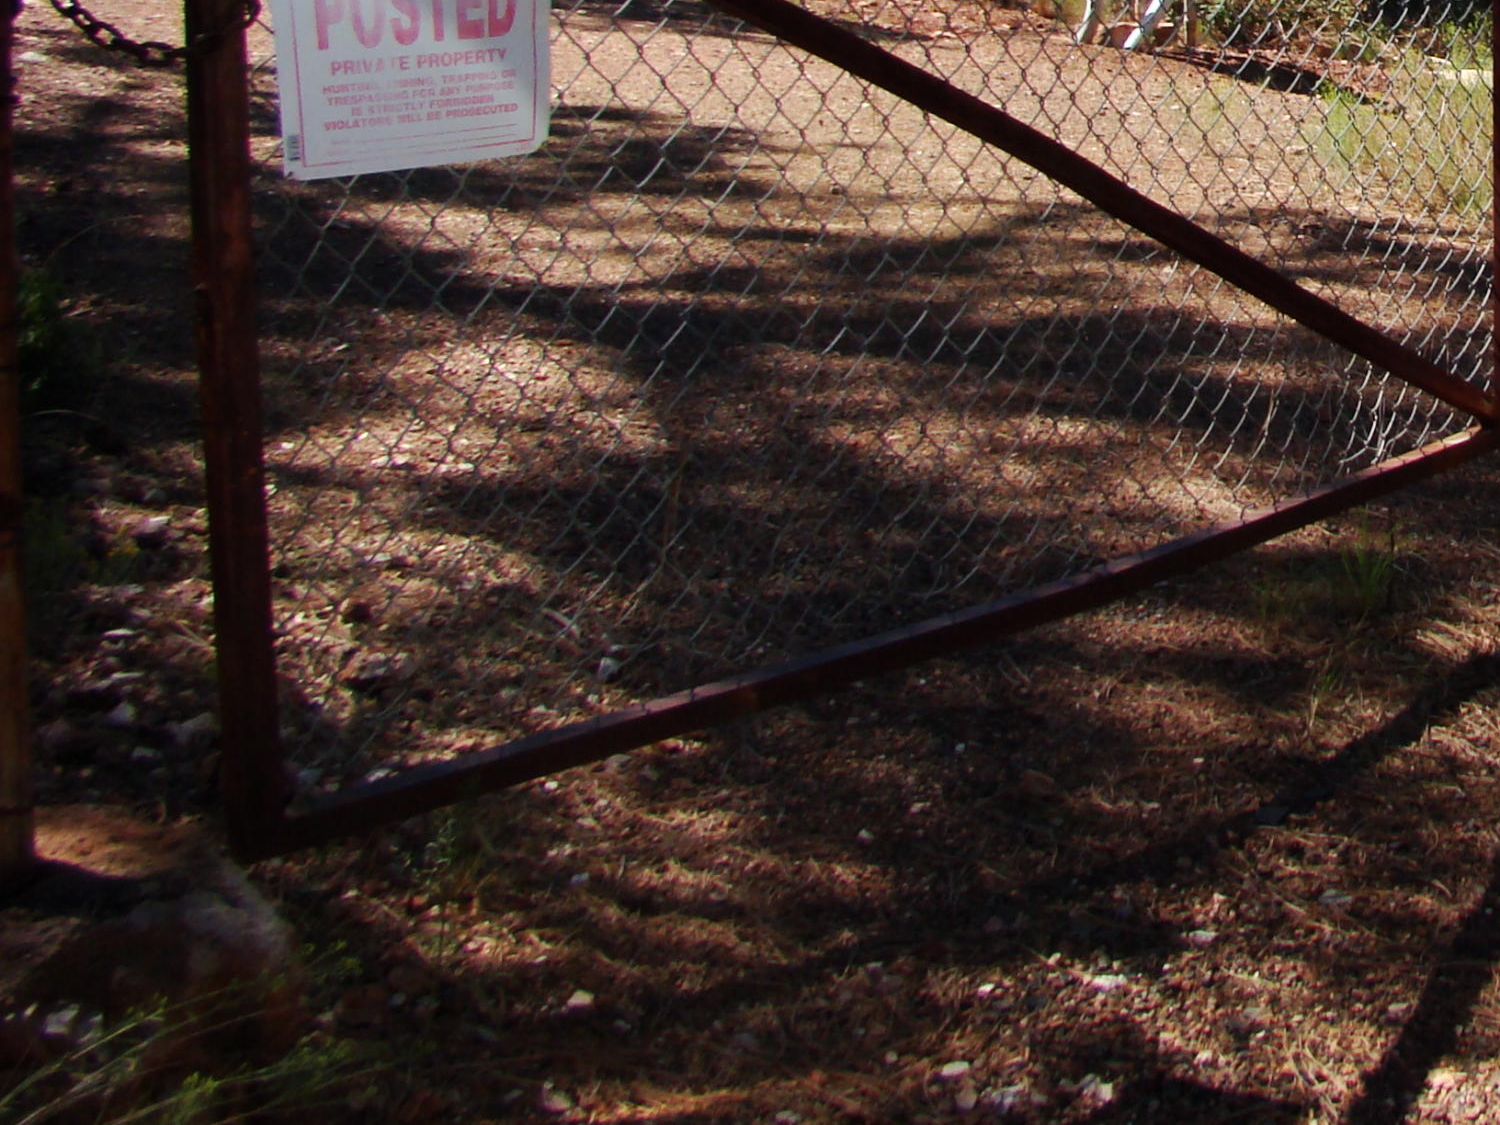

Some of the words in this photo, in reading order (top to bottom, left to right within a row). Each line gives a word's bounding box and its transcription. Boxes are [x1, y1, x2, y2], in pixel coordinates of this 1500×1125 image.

[417, 48, 507, 69] PROPERTY
[412, 88, 435, 99] FOR
[397, 112, 423, 124] WILL
[427, 111, 442, 121] BE
[446, 103, 519, 119] PROSECUTED
